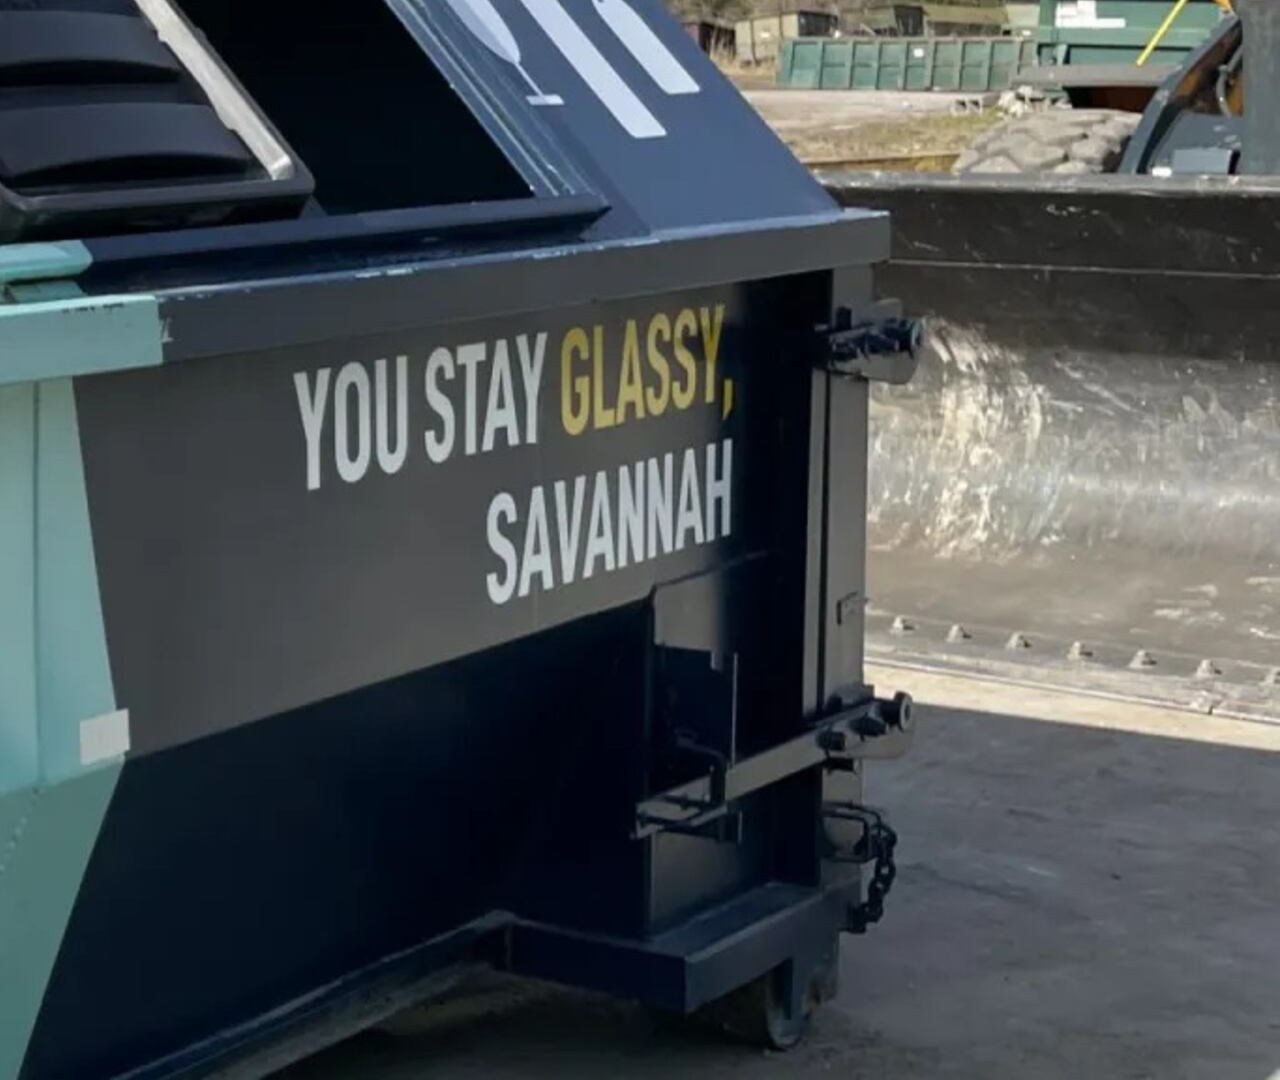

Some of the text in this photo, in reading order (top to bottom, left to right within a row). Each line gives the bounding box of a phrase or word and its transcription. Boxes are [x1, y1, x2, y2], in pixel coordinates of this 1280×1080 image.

[294, 304, 733, 490] YOU STAY GLASSY,
[486, 438, 733, 605] SAVANNAH
